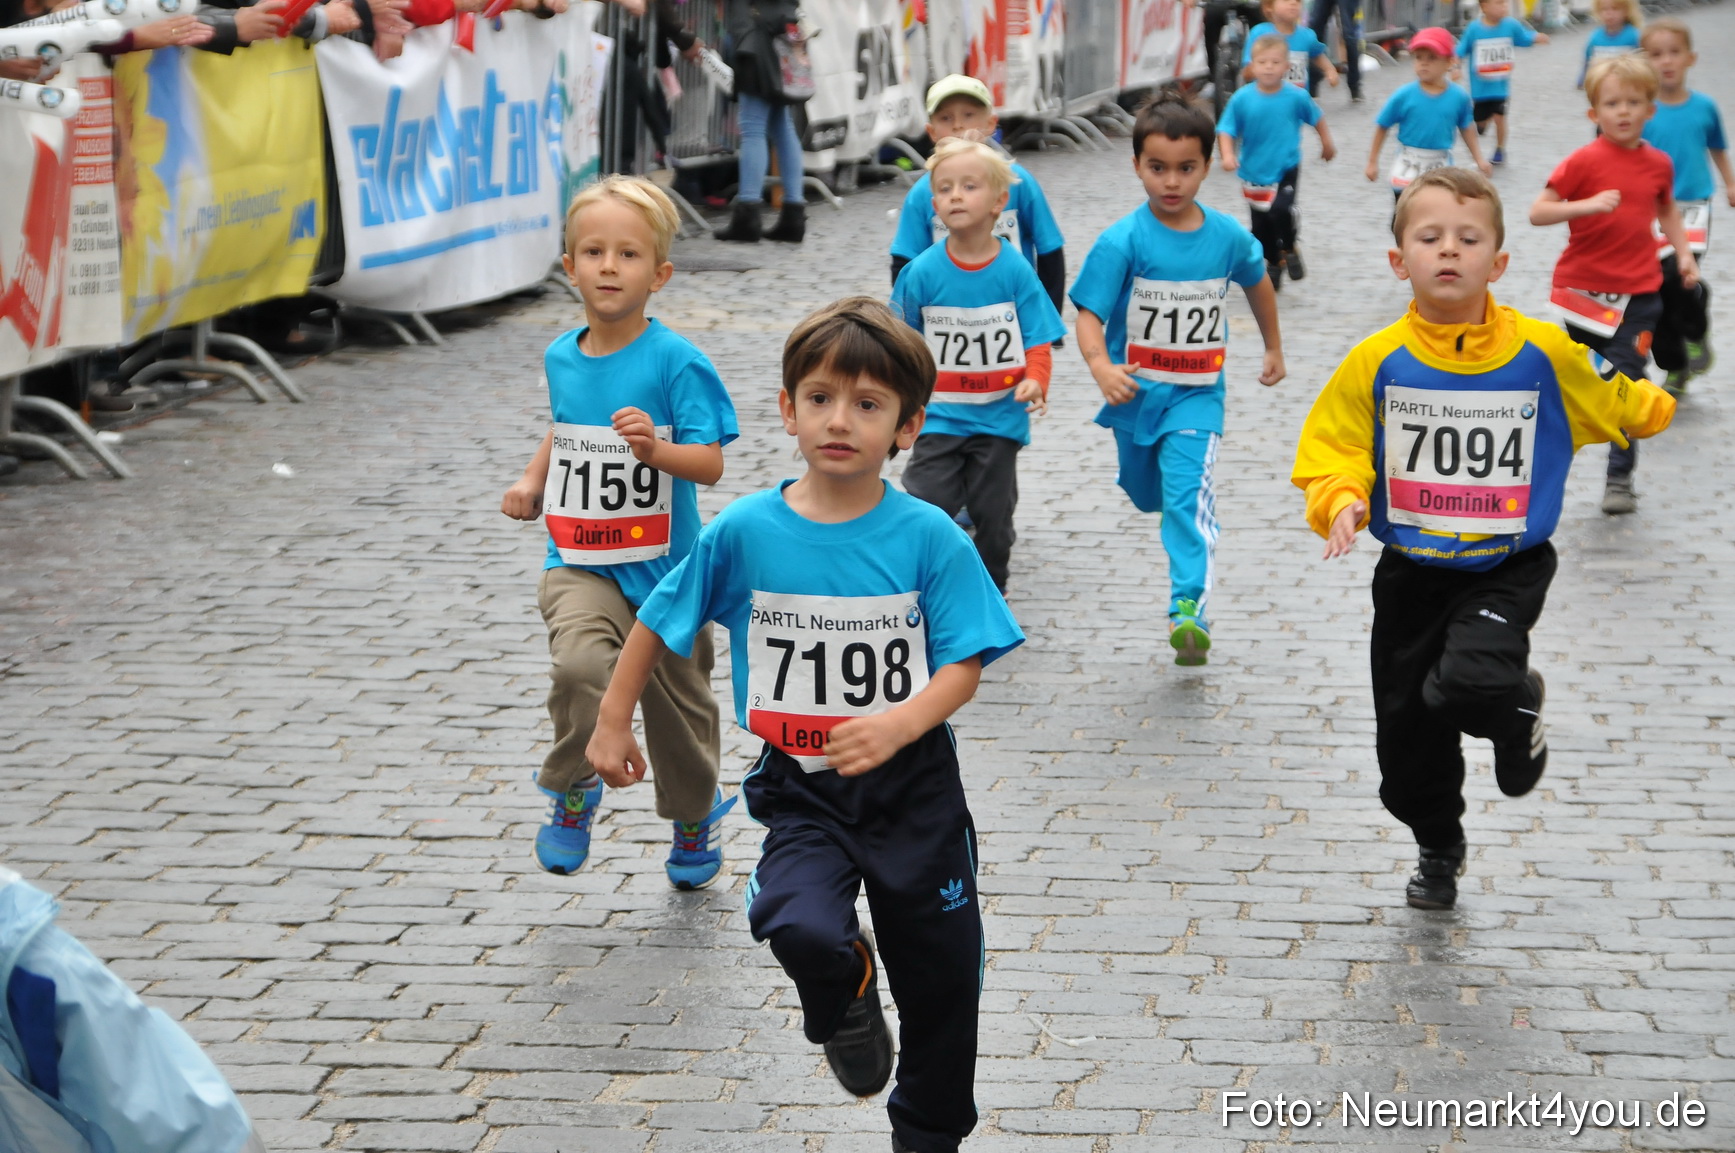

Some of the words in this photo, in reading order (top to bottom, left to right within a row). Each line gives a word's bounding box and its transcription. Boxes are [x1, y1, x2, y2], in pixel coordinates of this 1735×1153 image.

[1133, 287, 1167, 301] PARTL
[1170, 291, 1217, 302] Neumarkt
[926, 315, 954, 326] PARTL
[957, 315, 1002, 327] Neumarkt
[1139, 304, 1221, 344] 7122
[934, 328, 1015, 366] 7212
[1152, 352, 1211, 372] Raphael
[961, 375, 989, 390] Paul
[1390, 400, 1439, 417] PARTL
[1442, 405, 1515, 419] Neumarkt
[553, 436, 577, 452] PARTL
[580, 440, 633, 454] Neumar
[1402, 423, 1525, 479] 7094
[558, 458, 660, 511] 7159
[1419, 489, 1503, 513] Dominik
[573, 523, 623, 546] Quirin
[751, 609, 806, 629] PARTL
[811, 614, 899, 631] Neumarkt
[766, 637, 912, 707] 7198
[782, 722, 829, 749] Leo
[942, 896, 969, 912] adidas
